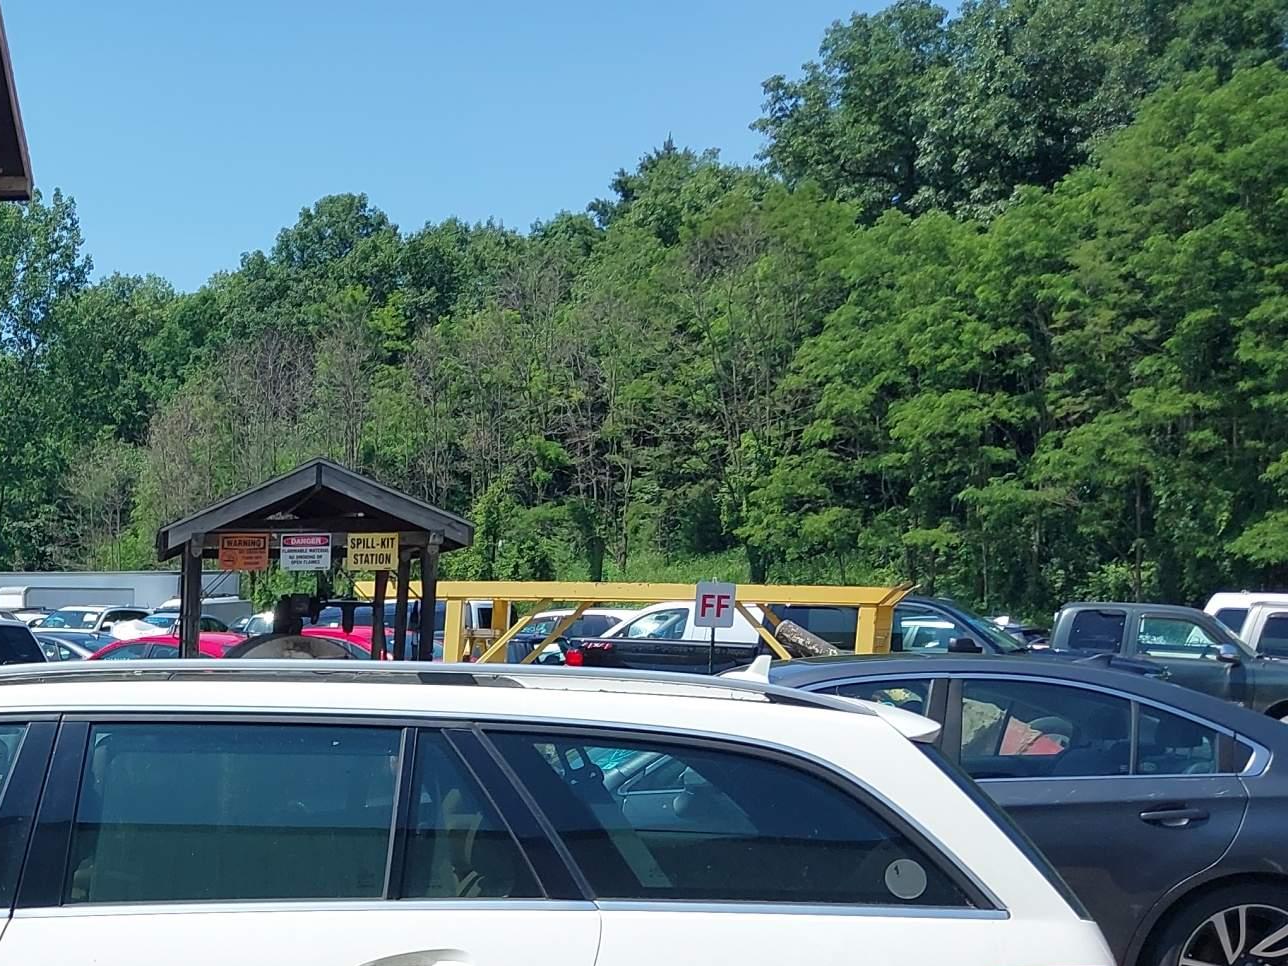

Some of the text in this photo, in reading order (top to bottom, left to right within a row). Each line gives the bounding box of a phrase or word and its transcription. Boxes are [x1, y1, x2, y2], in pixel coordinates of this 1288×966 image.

[291, 537, 320, 545] DANGER
[350, 537, 395, 549] SPILL-KIT
[353, 553, 392, 565] STATION
[701, 594, 730, 617] FF
